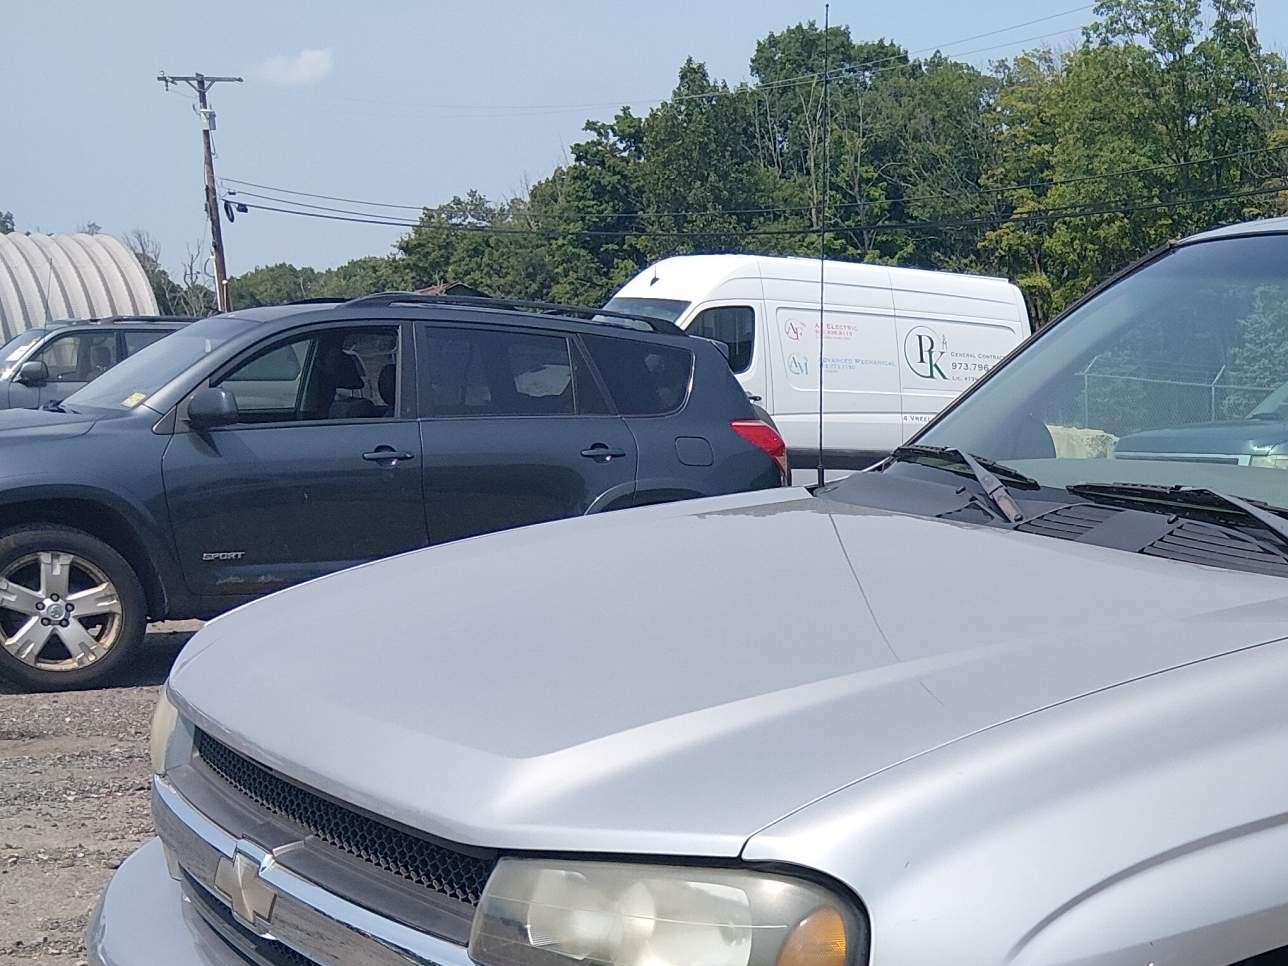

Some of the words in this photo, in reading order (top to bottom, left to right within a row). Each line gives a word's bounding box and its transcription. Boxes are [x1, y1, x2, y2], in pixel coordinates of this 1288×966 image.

[826, 323, 858, 331] ELECTRIC
[950, 351, 976, 359] GENERAL
[854, 358, 897, 367] MECHANICAL
[202, 551, 246, 561] SPORT
